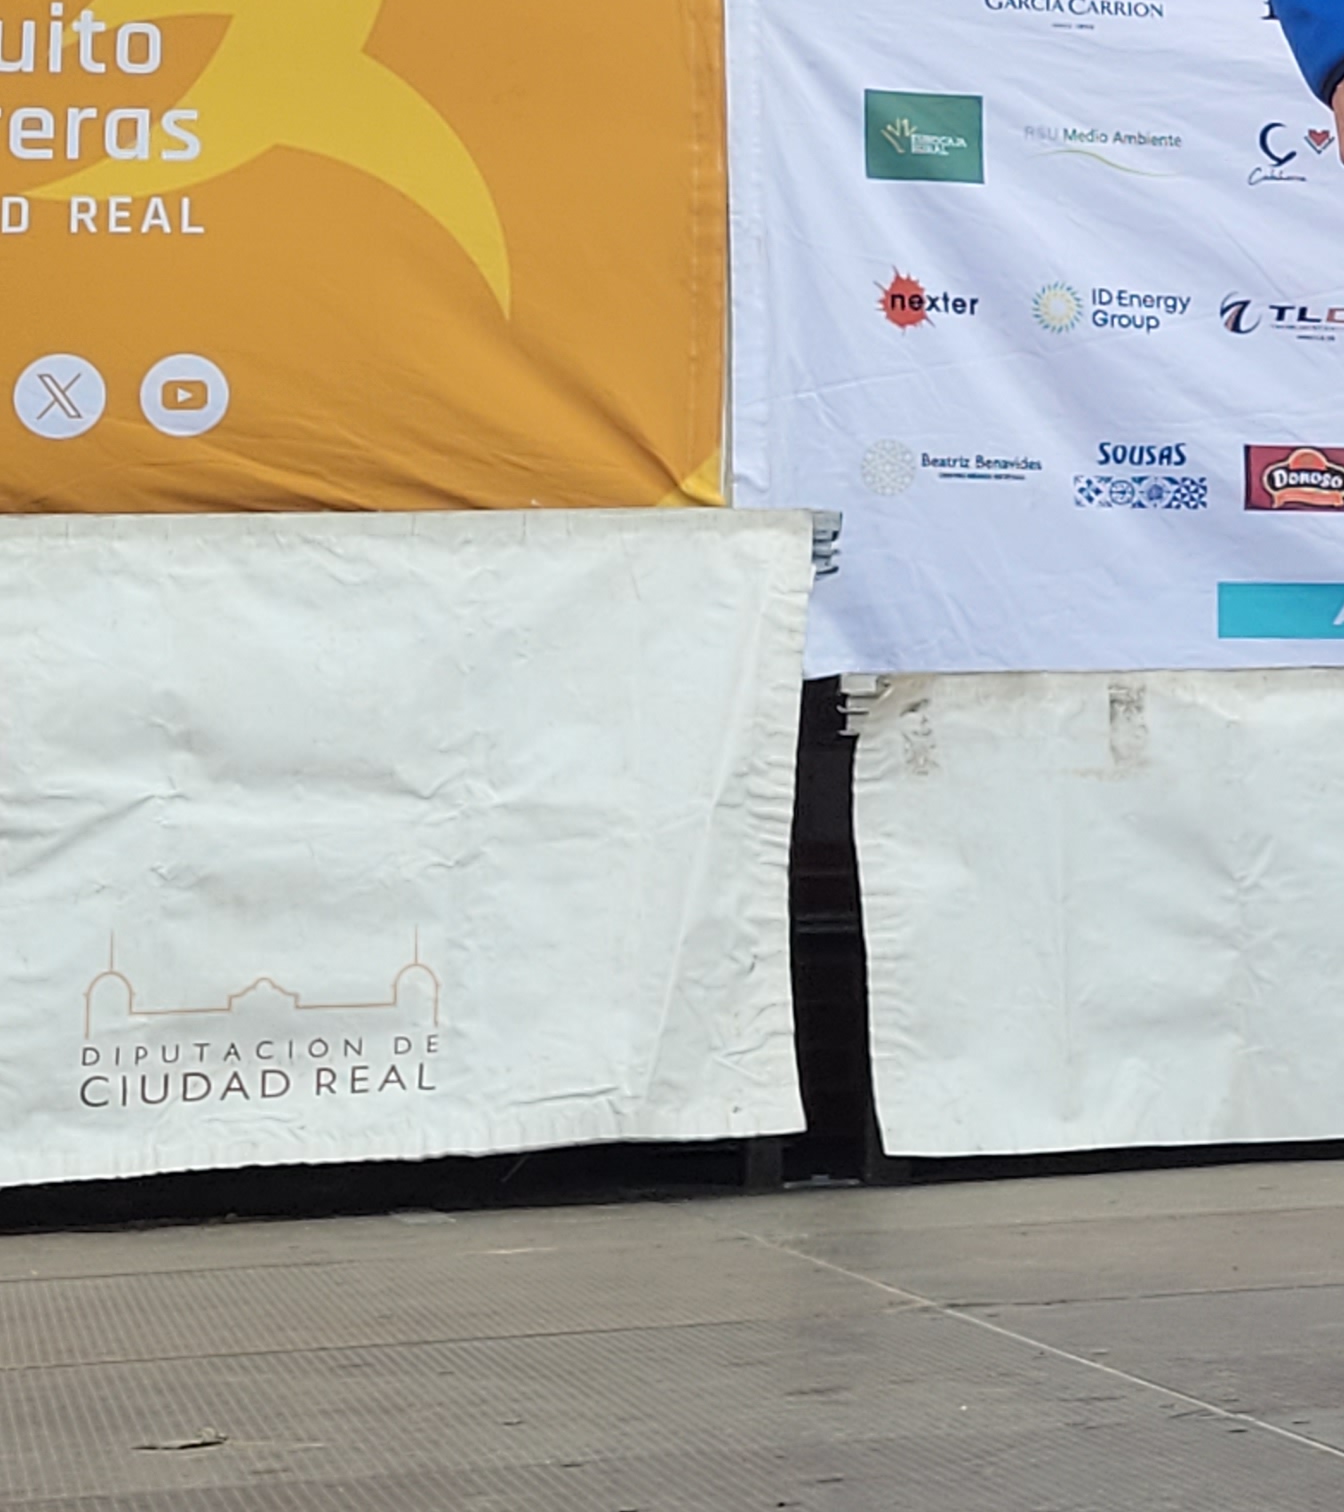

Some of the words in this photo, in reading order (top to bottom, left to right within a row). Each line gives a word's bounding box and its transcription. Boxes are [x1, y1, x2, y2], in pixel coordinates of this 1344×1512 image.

[0, 2, 162, 75] uito
[0, 105, 202, 162] eras
[1062, 128, 1108, 144] Medio
[1112, 130, 1183, 148] Ambiente
[70, 196, 206, 235] REAL
[890, 292, 979, 316] nexter
[1092, 288, 1113, 306] ID
[1116, 290, 1192, 315] Energy
[1092, 309, 1161, 334] Group
[920, 452, 970, 469] Beatriz
[974, 455, 1043, 471] Benavides
[1096, 442, 1187, 466] SOUSAS
[393, 1034, 441, 1056] DE
[80, 1069, 290, 1108] CIUDAD
[315, 1063, 436, 1096] REAL
